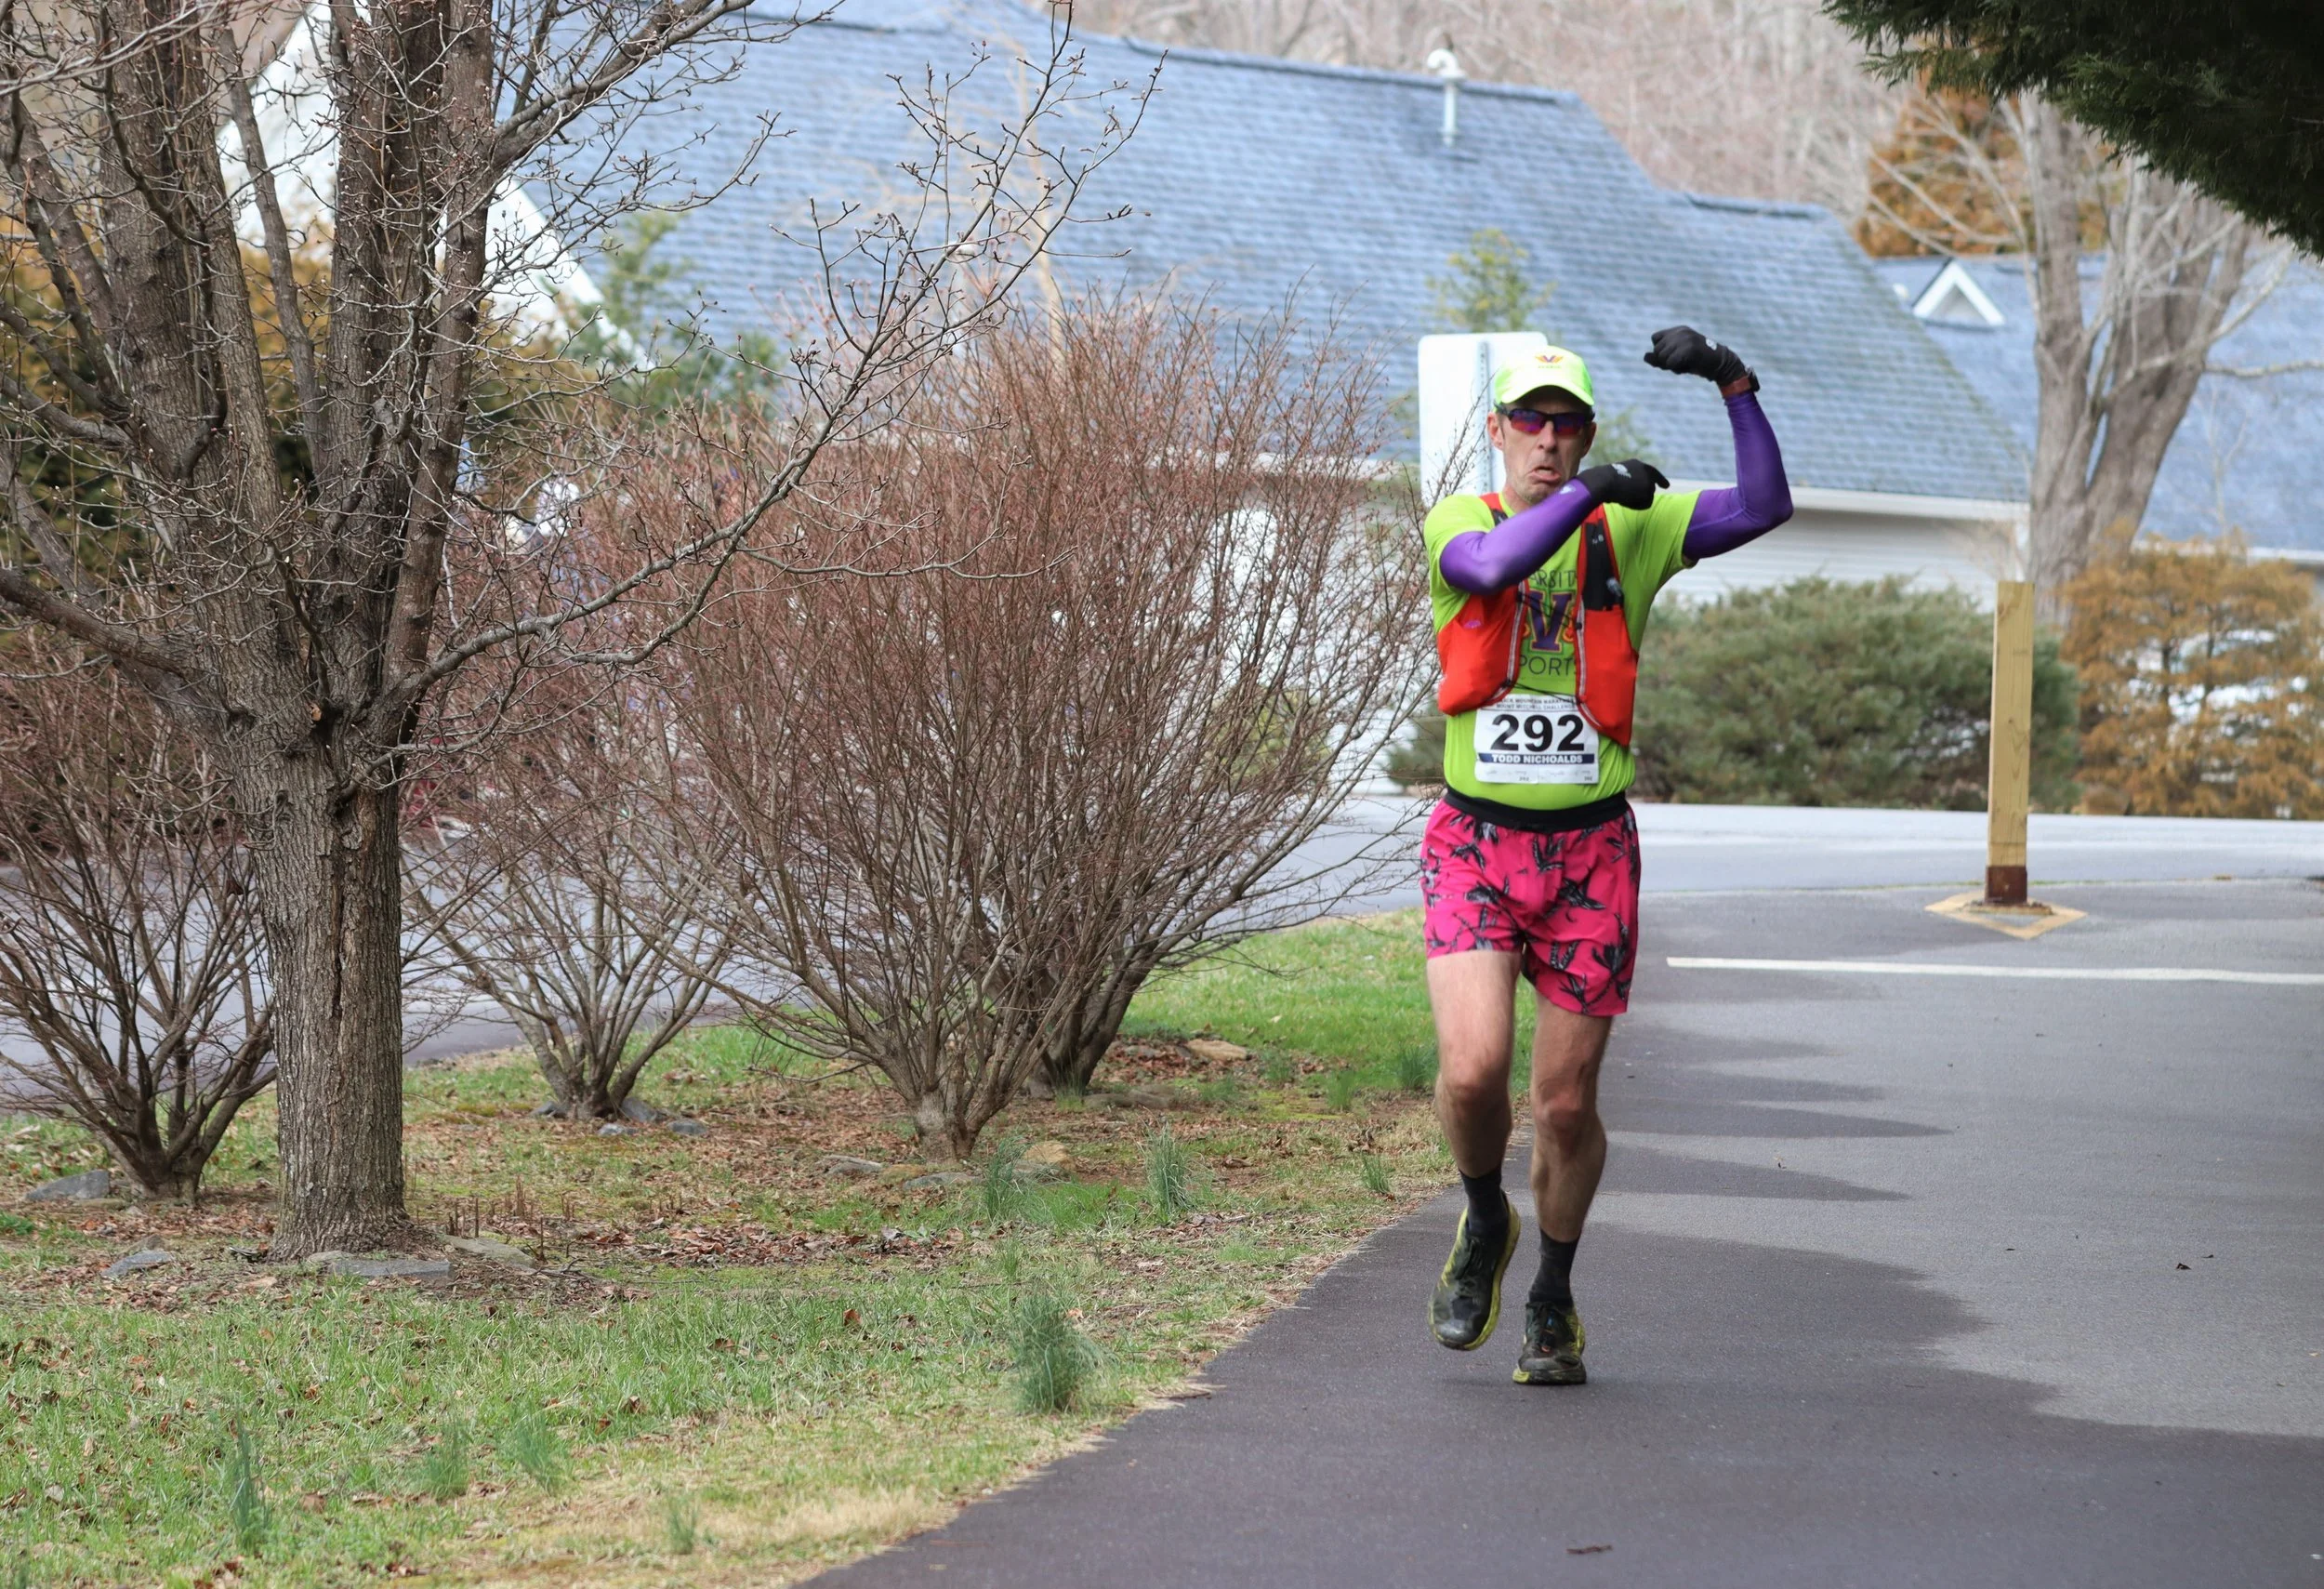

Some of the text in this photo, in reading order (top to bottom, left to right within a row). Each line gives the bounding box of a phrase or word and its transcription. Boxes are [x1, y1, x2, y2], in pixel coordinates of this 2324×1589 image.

[1490, 714, 1585, 752] 292
[1492, 754, 1583, 763] TODD NICHOALDS
